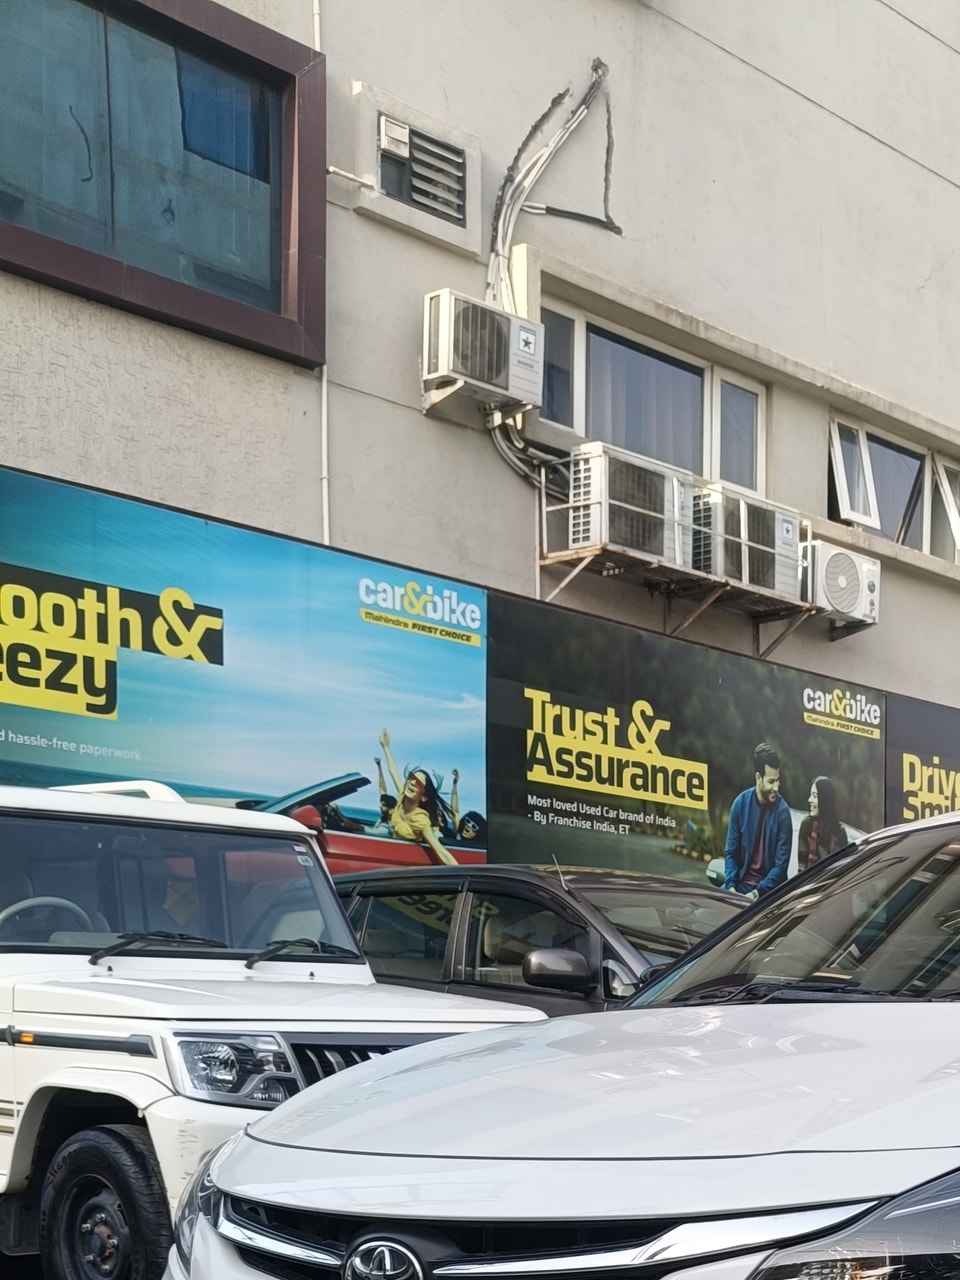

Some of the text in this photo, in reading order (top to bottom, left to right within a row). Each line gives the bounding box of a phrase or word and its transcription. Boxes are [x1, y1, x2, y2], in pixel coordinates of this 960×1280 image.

[358, 577, 482, 630] car&bike
[152, 586, 224, 664] &
[364, 610, 472, 643] Mahindra FIRST CHOICE
[0, 641, 118, 716] ezy
[523, 686, 672, 757] Trust &
[803, 687, 881, 725] car&bike
[8, 730, 77, 752] hassle-free
[79, 742, 142, 761] paperwork
[836, 722, 854, 732] FIRST
[853, 725, 875, 736] CHOICE
[525, 731, 706, 803] Assurance
[527, 793, 677, 828] Most loved Used Car brand of India
[533, 811, 547, 825] By
[548, 812, 592, 830] Franchise
[593, 820, 618, 835] India,
[618, 824, 631, 835] ET
